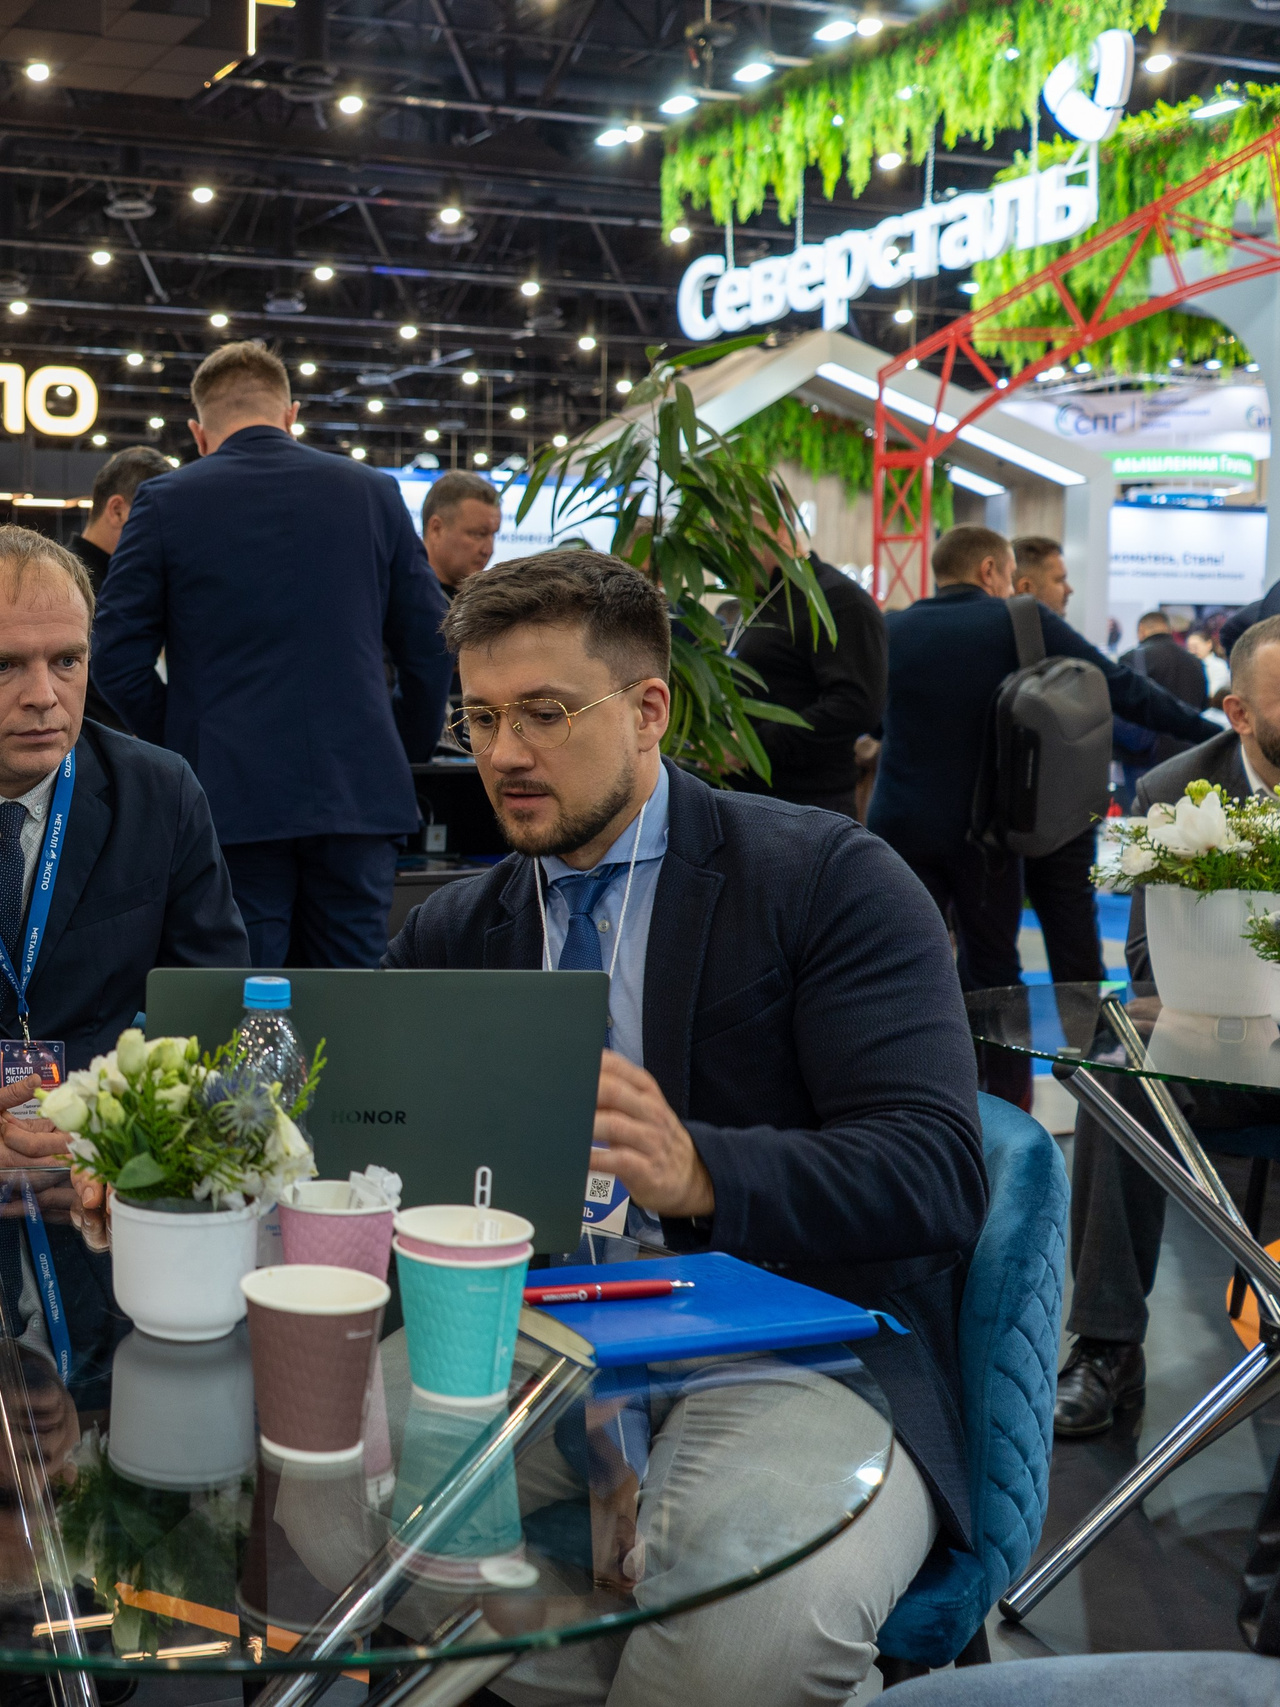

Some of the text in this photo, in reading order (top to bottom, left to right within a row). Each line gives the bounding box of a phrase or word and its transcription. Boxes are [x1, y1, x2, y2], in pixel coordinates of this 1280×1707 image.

[677, 164, 1098, 341] Северсталь
[41, 813, 63, 891] МЕТАЛЛ ЭКСПО
[27, 927, 40, 963] МЕТАЛЛ
[5, 1066, 34, 1076] МЕТАЛЛ
[331, 1110, 407, 1125] HONOR
